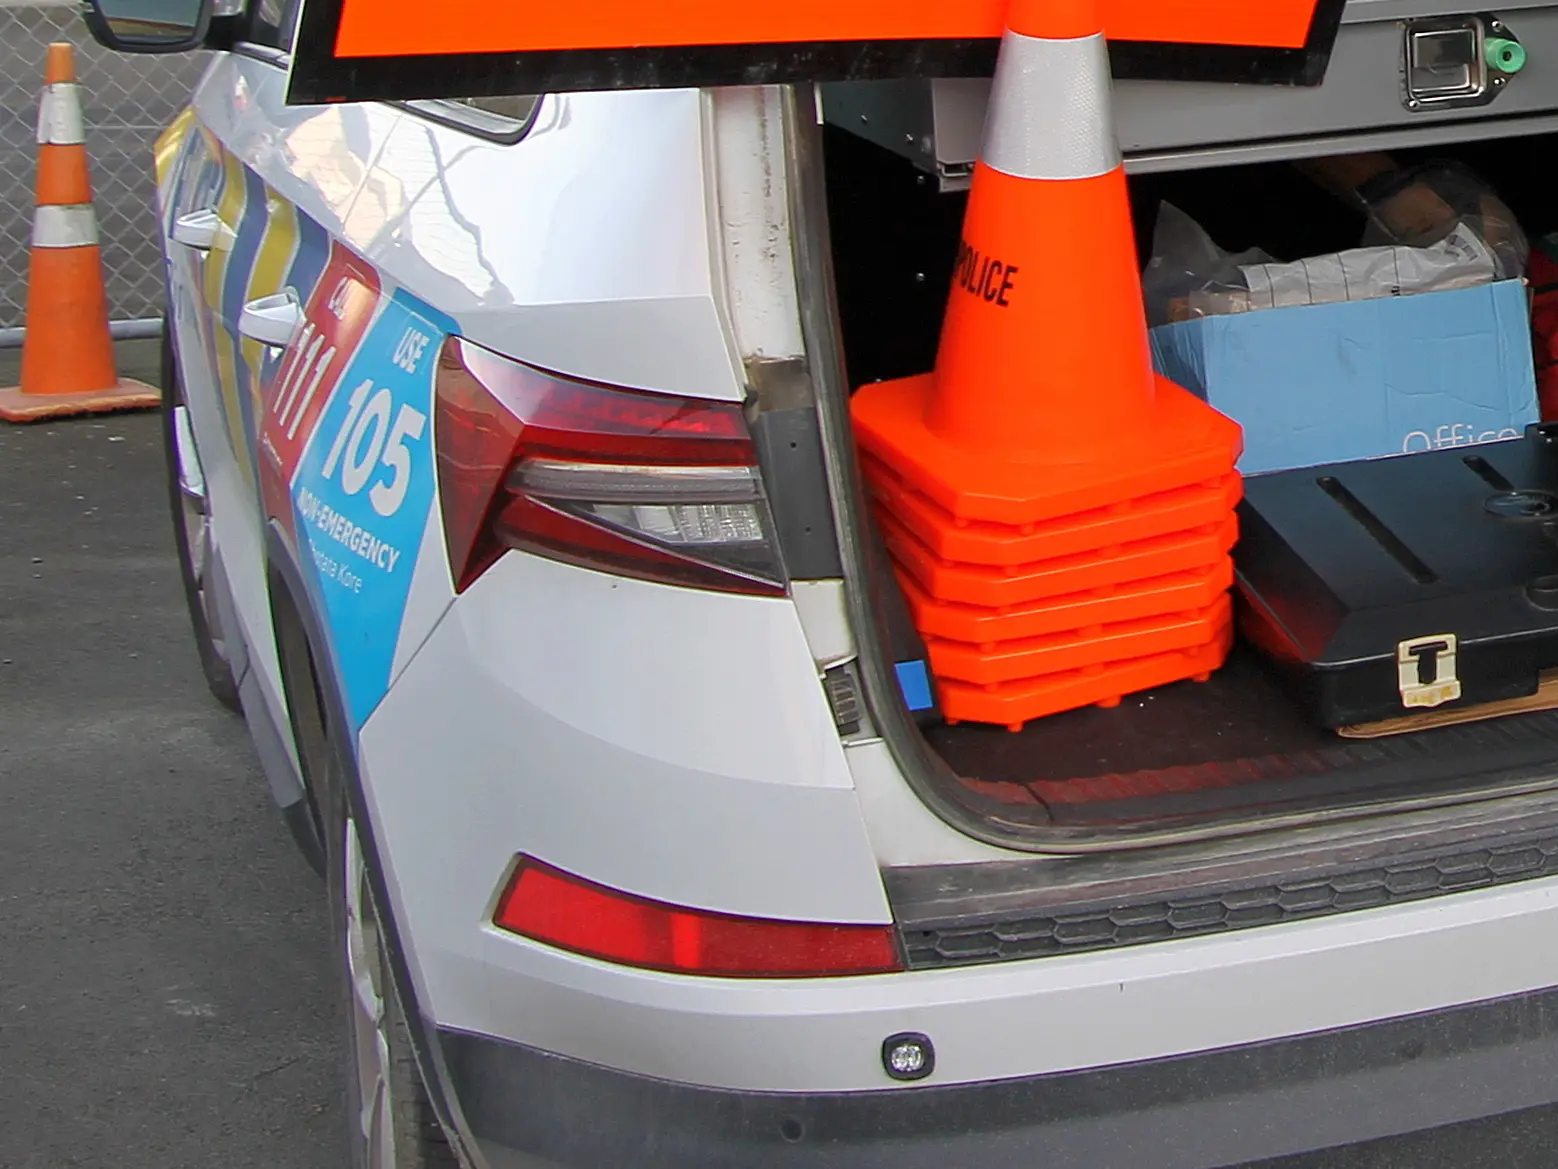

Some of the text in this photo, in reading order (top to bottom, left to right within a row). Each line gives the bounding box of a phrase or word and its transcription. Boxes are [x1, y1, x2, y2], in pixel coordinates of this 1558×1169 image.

[273, 322, 337, 440] 111
[392, 326, 431, 374] USE
[322, 378, 427, 517] 105
